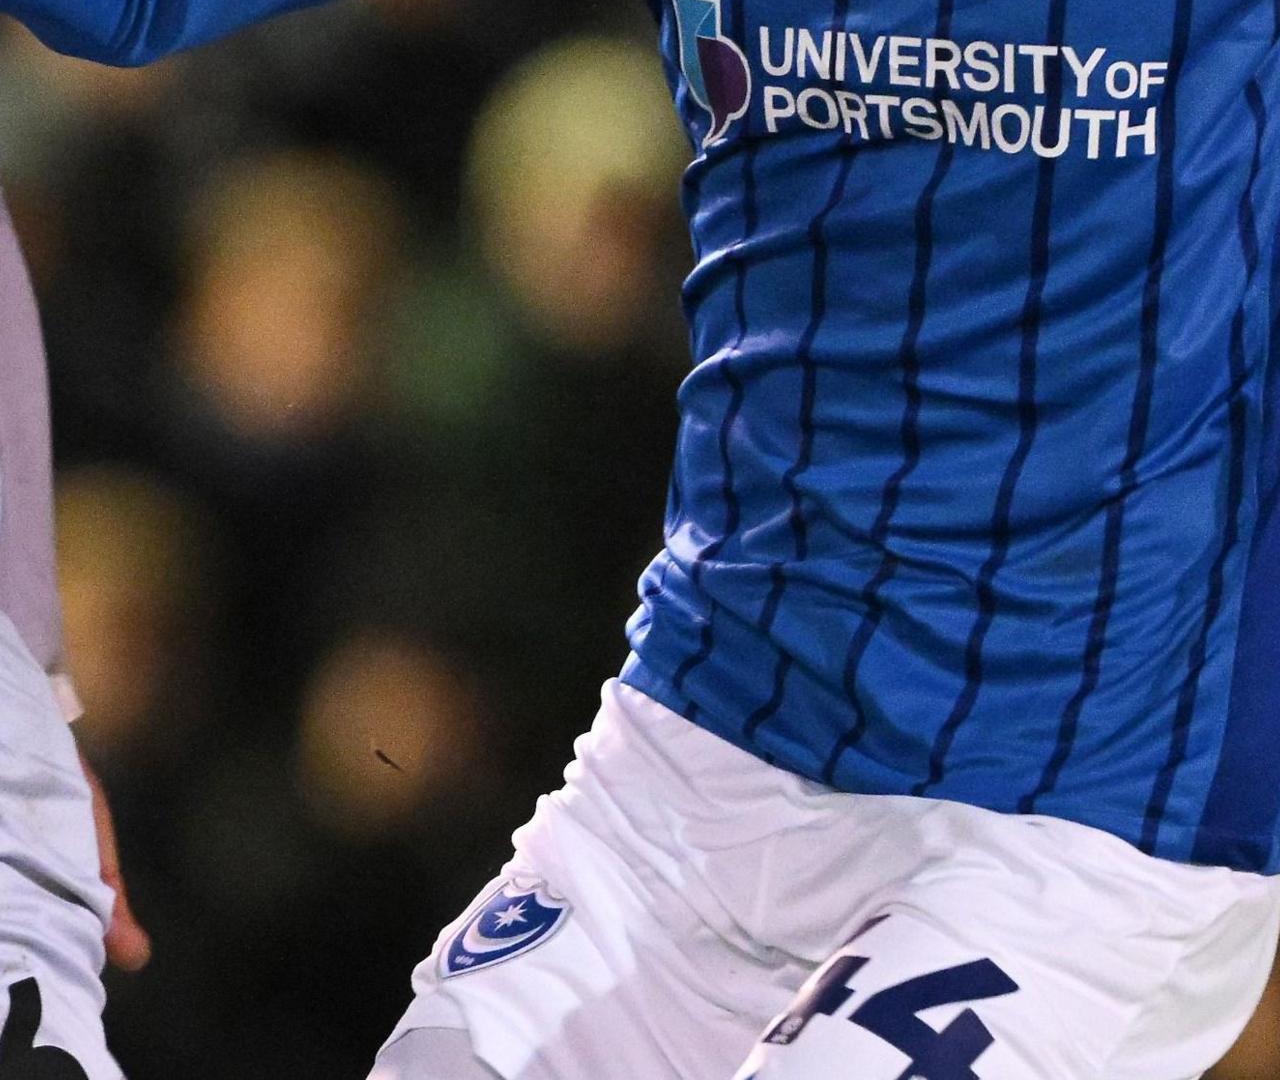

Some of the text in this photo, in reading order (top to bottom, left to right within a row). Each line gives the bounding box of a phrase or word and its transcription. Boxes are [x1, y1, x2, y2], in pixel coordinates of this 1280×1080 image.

[759, 26, 1169, 99] UNIVERSITY OF
[763, 86, 1157, 159] PORTSMOUTH
